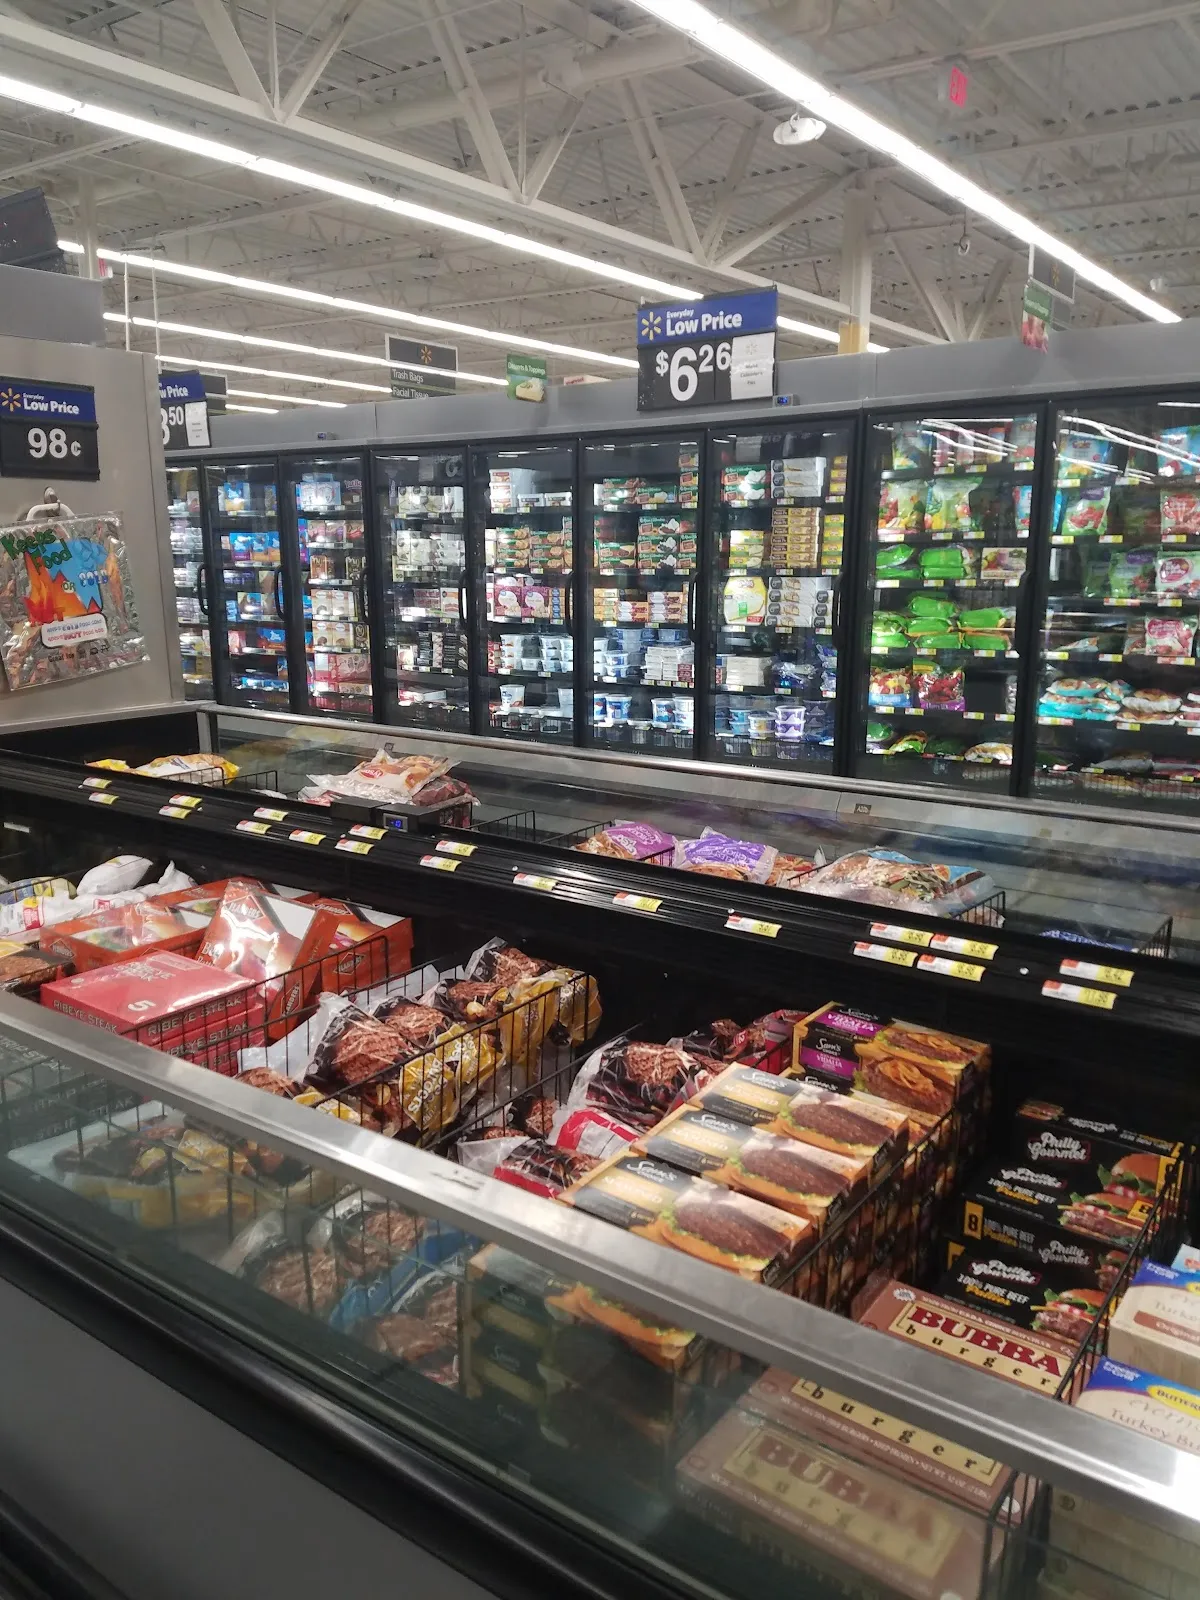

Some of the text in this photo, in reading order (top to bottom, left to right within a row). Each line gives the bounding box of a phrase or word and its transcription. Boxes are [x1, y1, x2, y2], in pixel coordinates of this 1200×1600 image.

[666, 309, 694, 318] Everyday
[666, 311, 743, 336] Low Price
[392, 369, 424, 383] Trash Bags
[23, 392, 45, 400] Everyday
[167, 385, 189, 397] Price
[392, 387, 409, 399] Facial
[23, 398, 80, 415] Low Price
[0, 529, 57, 561] Keeps
[29, 539, 73, 575] Food
[53, 999, 118, 1033] RIBEYE STEAK
[148, 997, 242, 1036] RIBEYE STEAK
[816, 1038, 842, 1052] Sam's
[816, 1056, 843, 1068] VIDALIA
[742, 1071, 788, 1089] Sam's
[690, 1114, 739, 1132] Sam's
[1041, 1132, 1082, 1149] Philly
[1028, 1142, 1087, 1161] Gourmet
[627, 1161, 678, 1181] Sam's
[1013, 1184, 1035, 1198] PURE
[1034, 1191, 1057, 1204] BEEF
[967, 1214, 979, 1232] 8
[1019, 1231, 1036, 1245] BEEF
[1038, 1248, 1091, 1265] Gourmet
[1050, 1239, 1086, 1258] Philly
[971, 1262, 1037, 1285] Gourmet
[988, 1259, 1033, 1277] Philly
[956, 1273, 1031, 1305] 100% PURE BEEF
[907, 1306, 1062, 1377] BUBBA
[1110, 1408, 1170, 1440] Turkey
